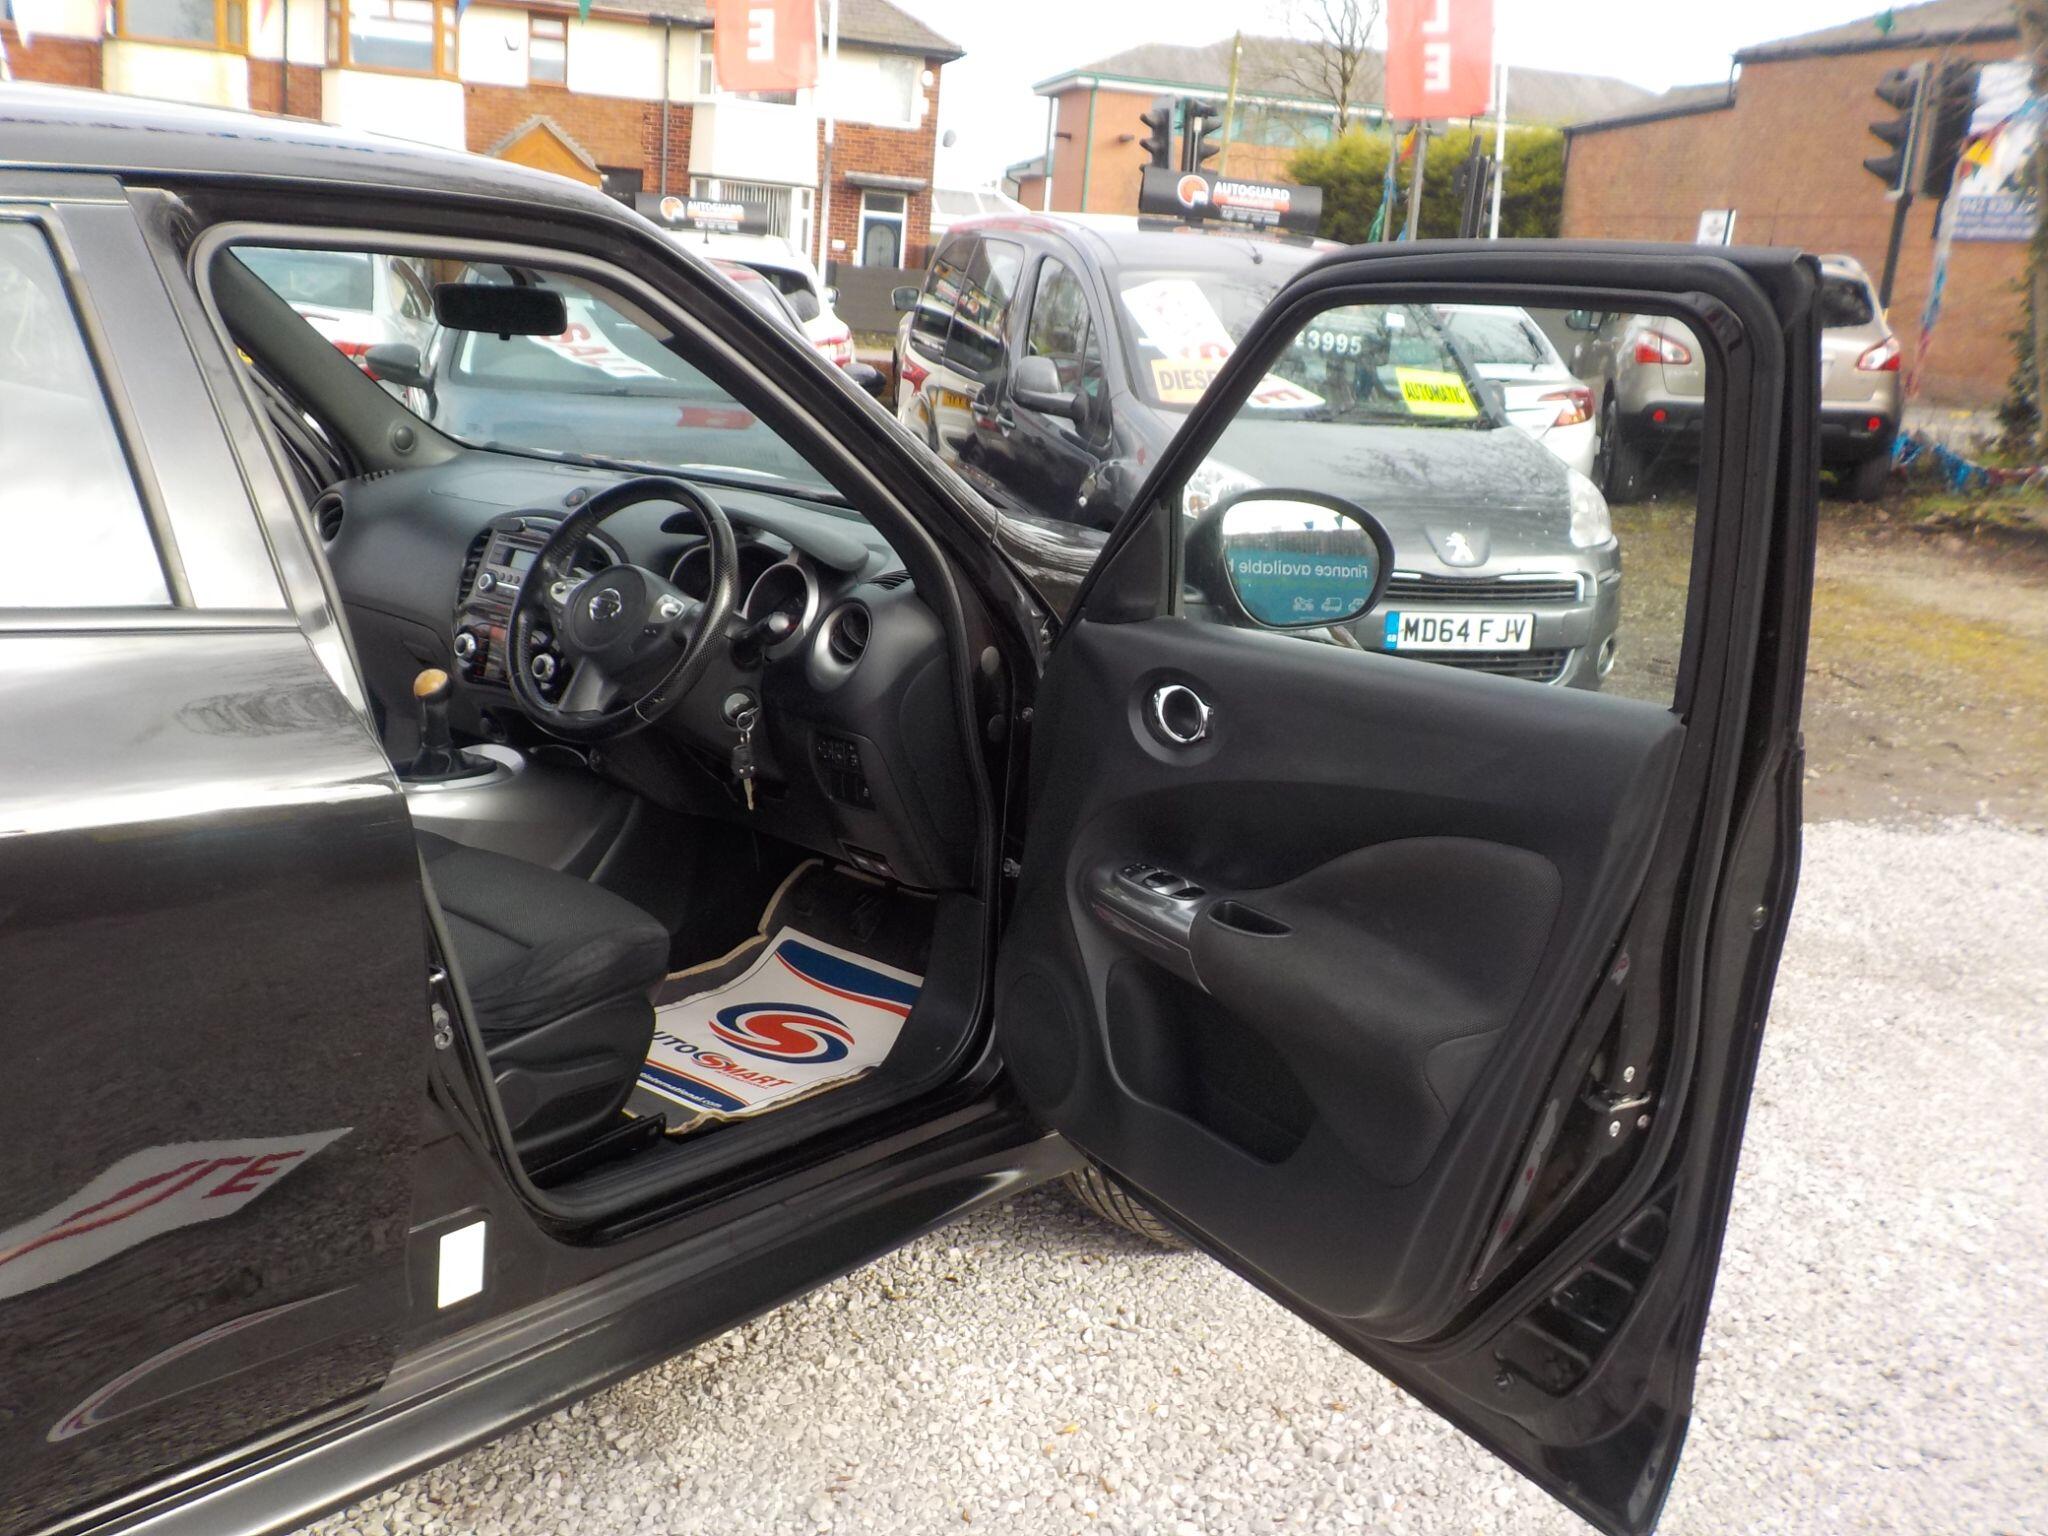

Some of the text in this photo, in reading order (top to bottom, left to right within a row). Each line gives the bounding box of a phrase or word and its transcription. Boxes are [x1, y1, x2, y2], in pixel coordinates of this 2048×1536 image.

[1214, 181, 1291, 201] AUTOGUARD
[1404, 381, 1465, 404] AUTOMATIC
[1403, 617, 1526, 643] MD64 FJV
